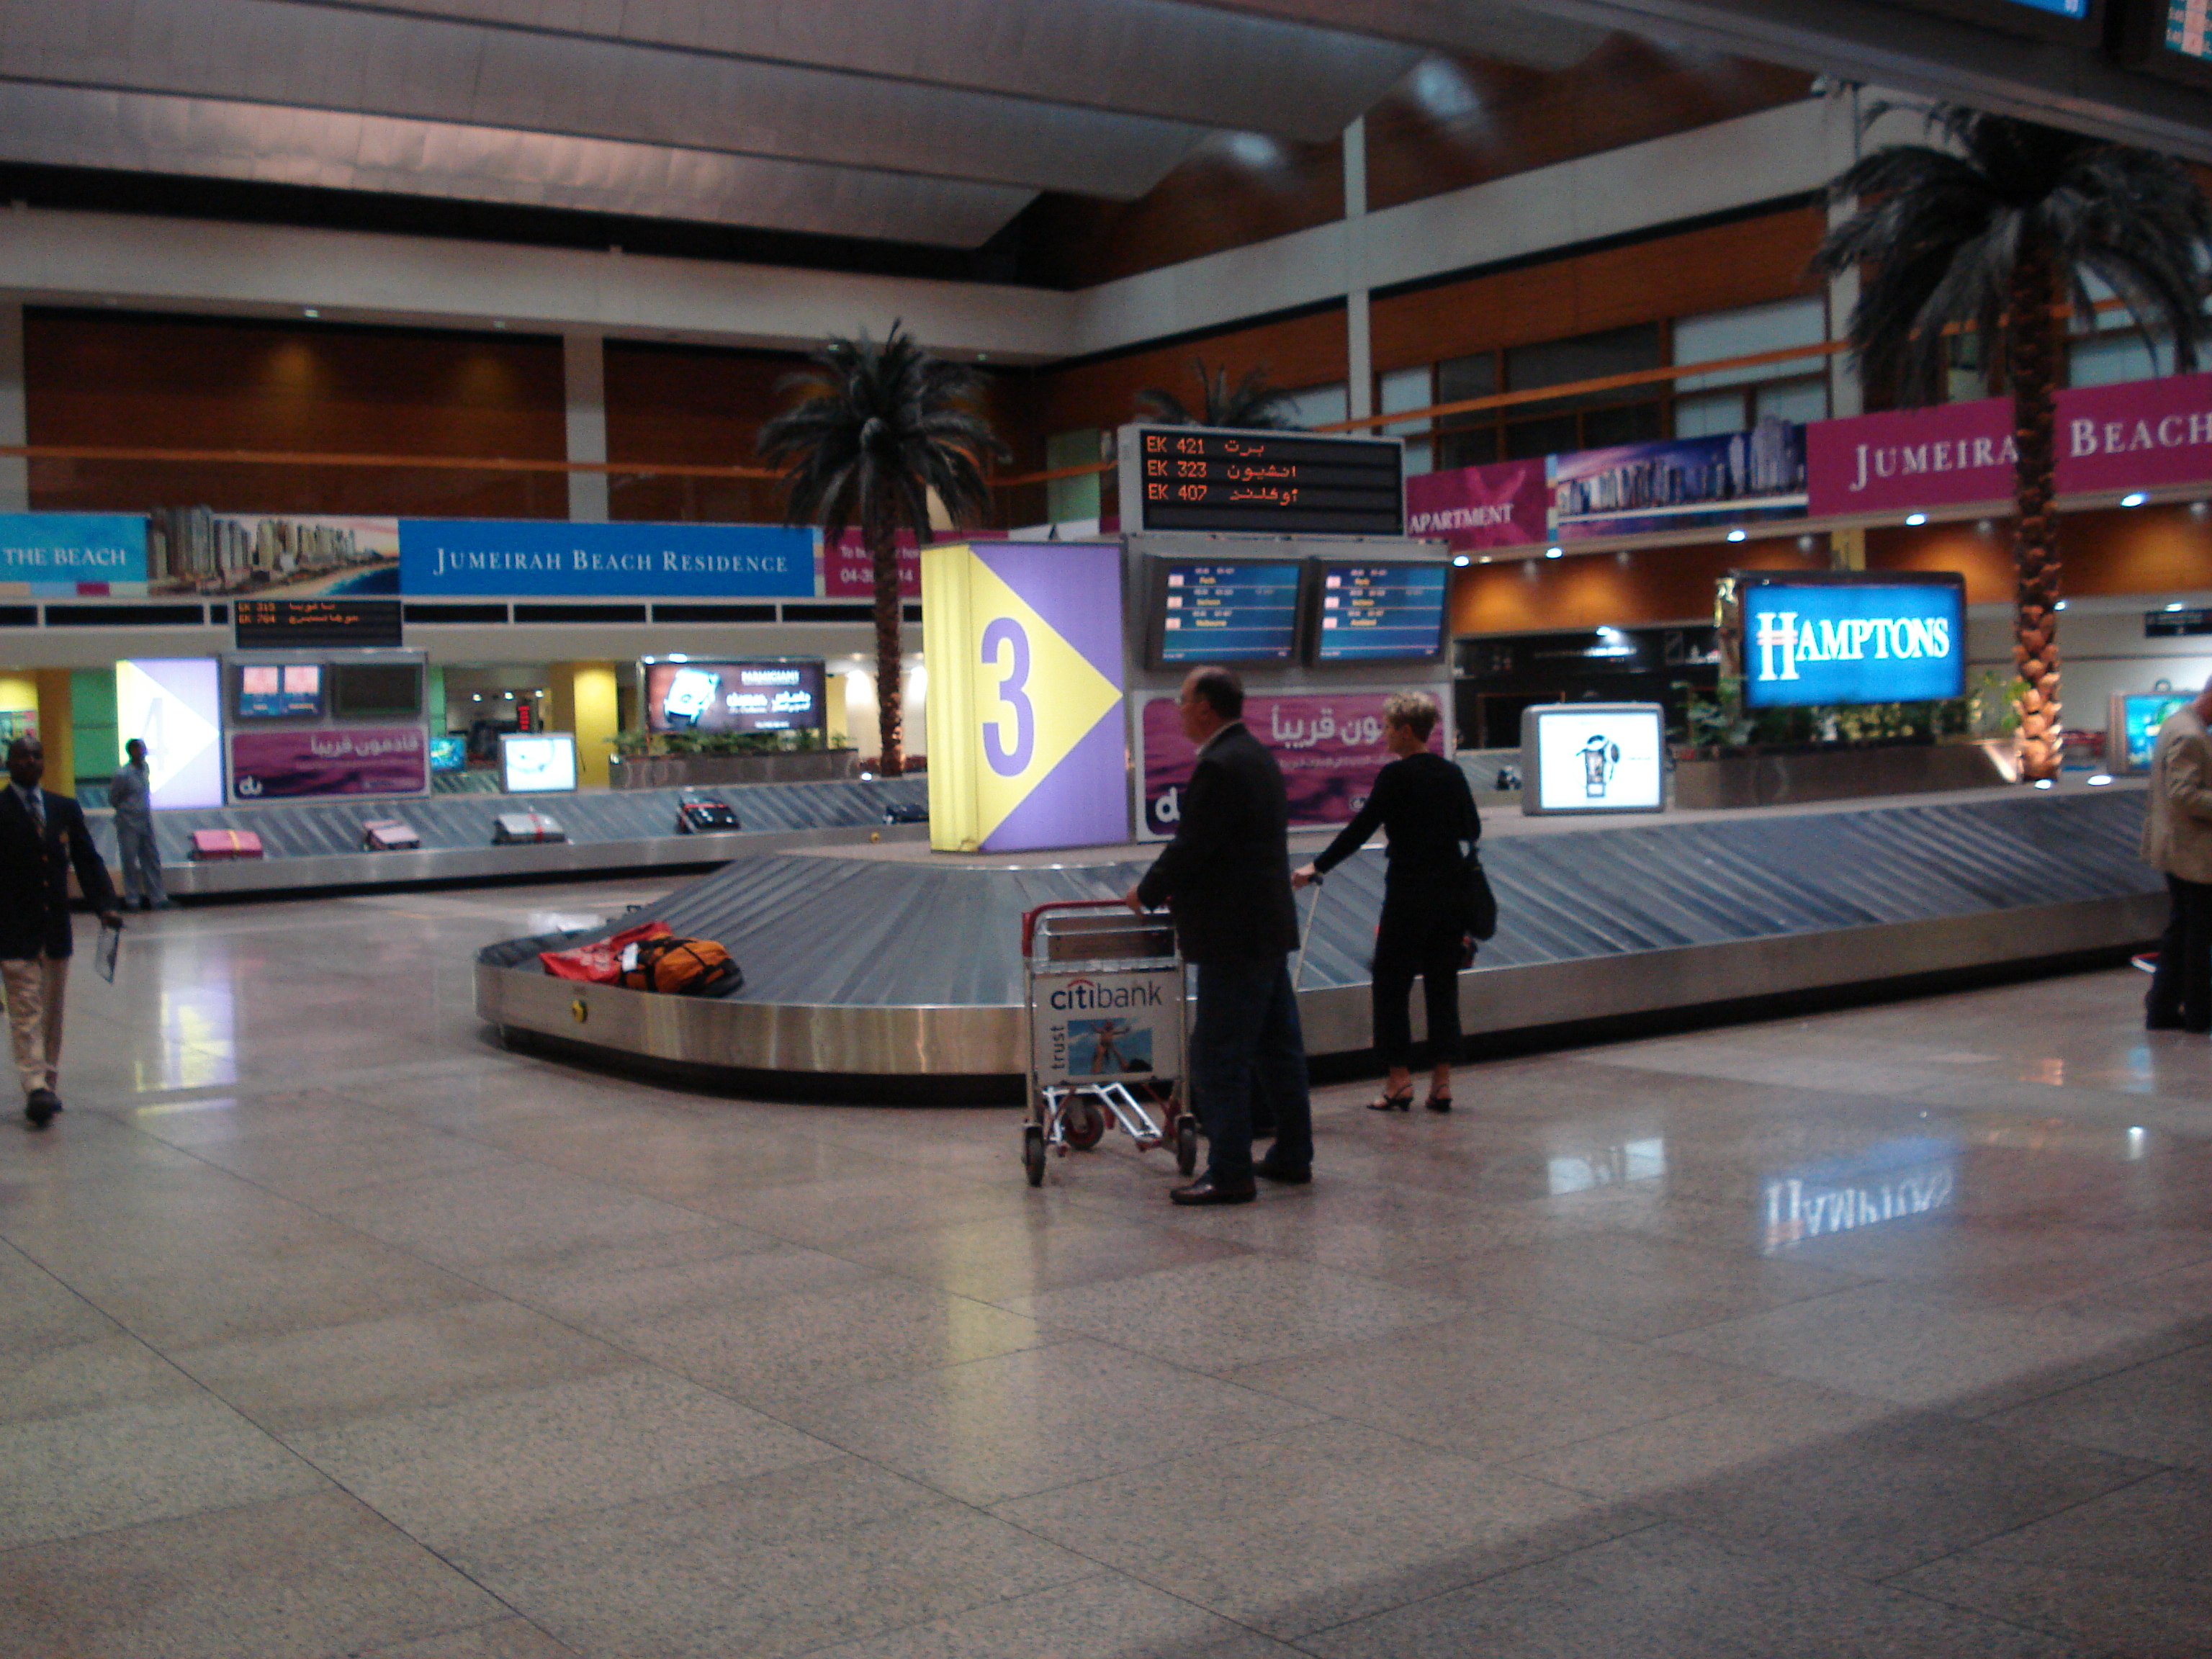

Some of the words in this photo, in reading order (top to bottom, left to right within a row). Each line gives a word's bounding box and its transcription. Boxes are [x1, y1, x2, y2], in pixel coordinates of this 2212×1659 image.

[1146, 435, 1167, 453] EK
[1176, 438, 1205, 454] 421
[1848, 434, 2019, 492] JUMEIRA
[2069, 412, 2212, 458] BEACH
[1147, 459, 1168, 477] EK
[1177, 461, 1208, 477] 323
[1148, 482, 1169, 500] EK
[1178, 484, 1208, 501] 407
[1408, 501, 1514, 536] APARTMENT
[3, 548, 48, 566] THE
[54, 547, 126, 566] BEACH
[432, 547, 561, 576] JUMEIRAH
[572, 549, 652, 571] BEACH
[662, 551, 788, 572] RESIDENCE
[1756, 612, 1950, 680] HAMPTONS
[981, 617, 1035, 777] 3
[142, 697, 170, 772] 4
[1155, 786, 1181, 824] d
[1050, 980, 1161, 1010] citibank
[1050, 1025, 1065, 1070] trust
